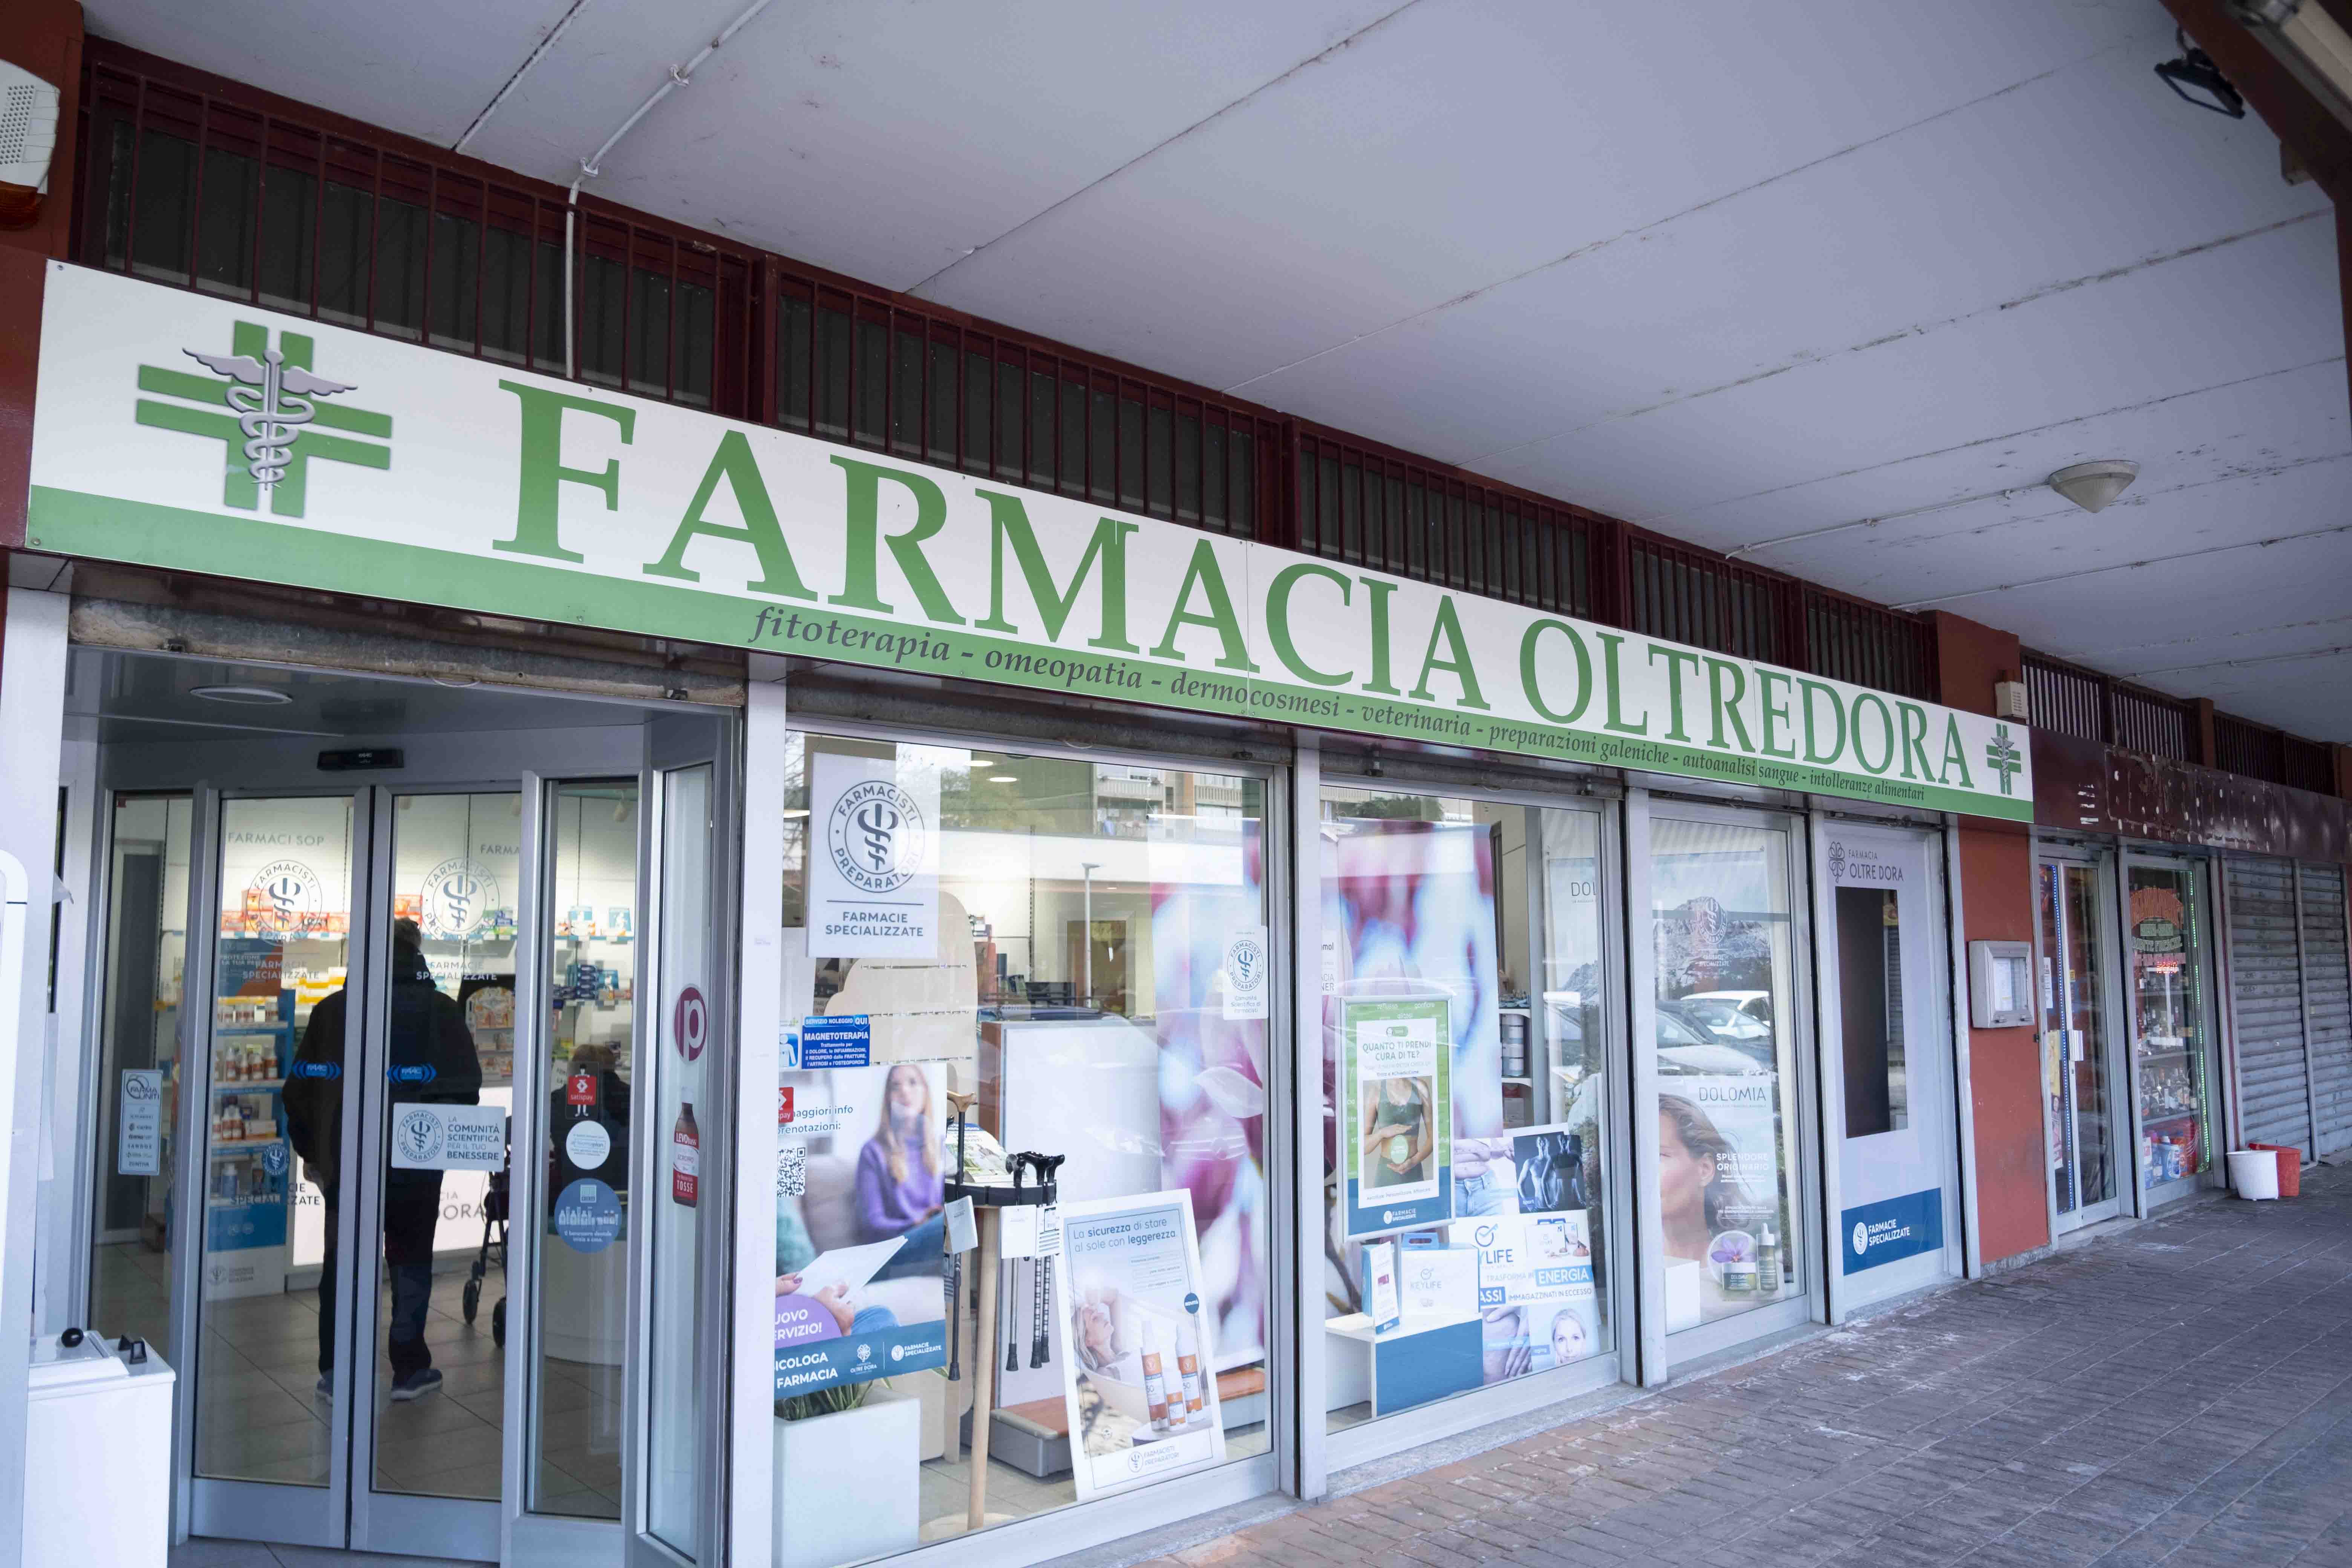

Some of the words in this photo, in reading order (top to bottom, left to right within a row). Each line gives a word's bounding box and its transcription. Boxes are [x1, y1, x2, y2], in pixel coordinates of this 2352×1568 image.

[492, 378, 1491, 710] FARMACIA
[1519, 618, 1975, 789] OLTREDORA
[748, 606, 950, 663] fitoterapia
[985, 649, 1142, 688] omeopatia
[1170, 671, 1339, 716] dermocosmesi
[1361, 704, 1470, 735] veterinaria
[1489, 724, 1597, 753] preparazioni
[1600, 739, 1669, 763] galeniche
[1682, 753, 1755, 777] autoanalisi
[1758, 766, 1798, 786] sangue
[1810, 769, 1873, 793] intolleranze
[1874, 781, 1925, 800] alimentari
[838, 784, 917, 822] FARMACISTI
[228, 832, 291, 844] FARMACI
[1848, 849, 1878, 860] FARMACIA
[254, 863, 316, 890] FARMACISTI
[427, 861, 493, 888] FARMACISTI
[1849, 862, 1876, 880] OLTRE
[1879, 865, 1904, 881] DORA
[842, 911, 908, 923] FARMACIE
[825, 924, 923, 937] SPECIALIZZATE
[1230, 942, 1260, 958] FARMACISTI
[1321, 942, 1334, 950] mol
[242, 971, 320, 980] SPECIALIZZATE
[1230, 971, 1262, 990] PREPARATORI
[804, 1032, 869, 1041] MAGNETOTERAPIA
[1363, 1043, 1395, 1054] QUANTO
[1405, 1040, 1432, 1049] PRENDI
[1375, 1052, 1396, 1061] CURA
[1699, 1086, 1767, 1101] DOLOMIA
[835, 1105, 853, 1114] info
[402, 1112, 440, 1129] FARMACISTI
[447, 1122, 500, 1134] COMUNITÀ
[447, 1133, 499, 1143] SCIENTIFICA
[676, 1132, 697, 1146] LEVOtuss
[400, 1142, 441, 1160] PREPARATORI
[447, 1151, 499, 1161] BENESSERE
[1716, 1153, 1767, 1161] SPLENDORE
[677, 1180, 694, 1193] TOSSE
[1073, 1230, 1084, 1239] La
[1088, 1224, 1131, 1237] sicurezza
[1133, 1220, 1142, 1231] di
[1144, 1217, 1167, 1229] stare
[1868, 1219, 1897, 1235] FARMACIE
[1074, 1243, 1083, 1253] al
[1086, 1238, 1106, 1251] sole
[1108, 1237, 1125, 1248] con
[1127, 1230, 1176, 1246] leggerezza
[1869, 1227, 1911, 1246] SPECIALIZZATE
[1487, 1272, 1527, 1282] TRASFORMA
[1537, 1268, 1589, 1284] ENERGIA
[1410, 1281, 1442, 1289] KEYLIFE
[1508, 1290, 1557, 1301] IMMAGAZZINATI
[1565, 1288, 1592, 1297] ECCESSO
[905, 1342, 929, 1351] FARMACIE
[905, 1345, 942, 1357] SPECIALIZZATE
[775, 1352, 828, 1371] ICOLOGA
[776, 1368, 838, 1388] FARMACIA
[1144, 1452, 1179, 1466] PREPARATORI
